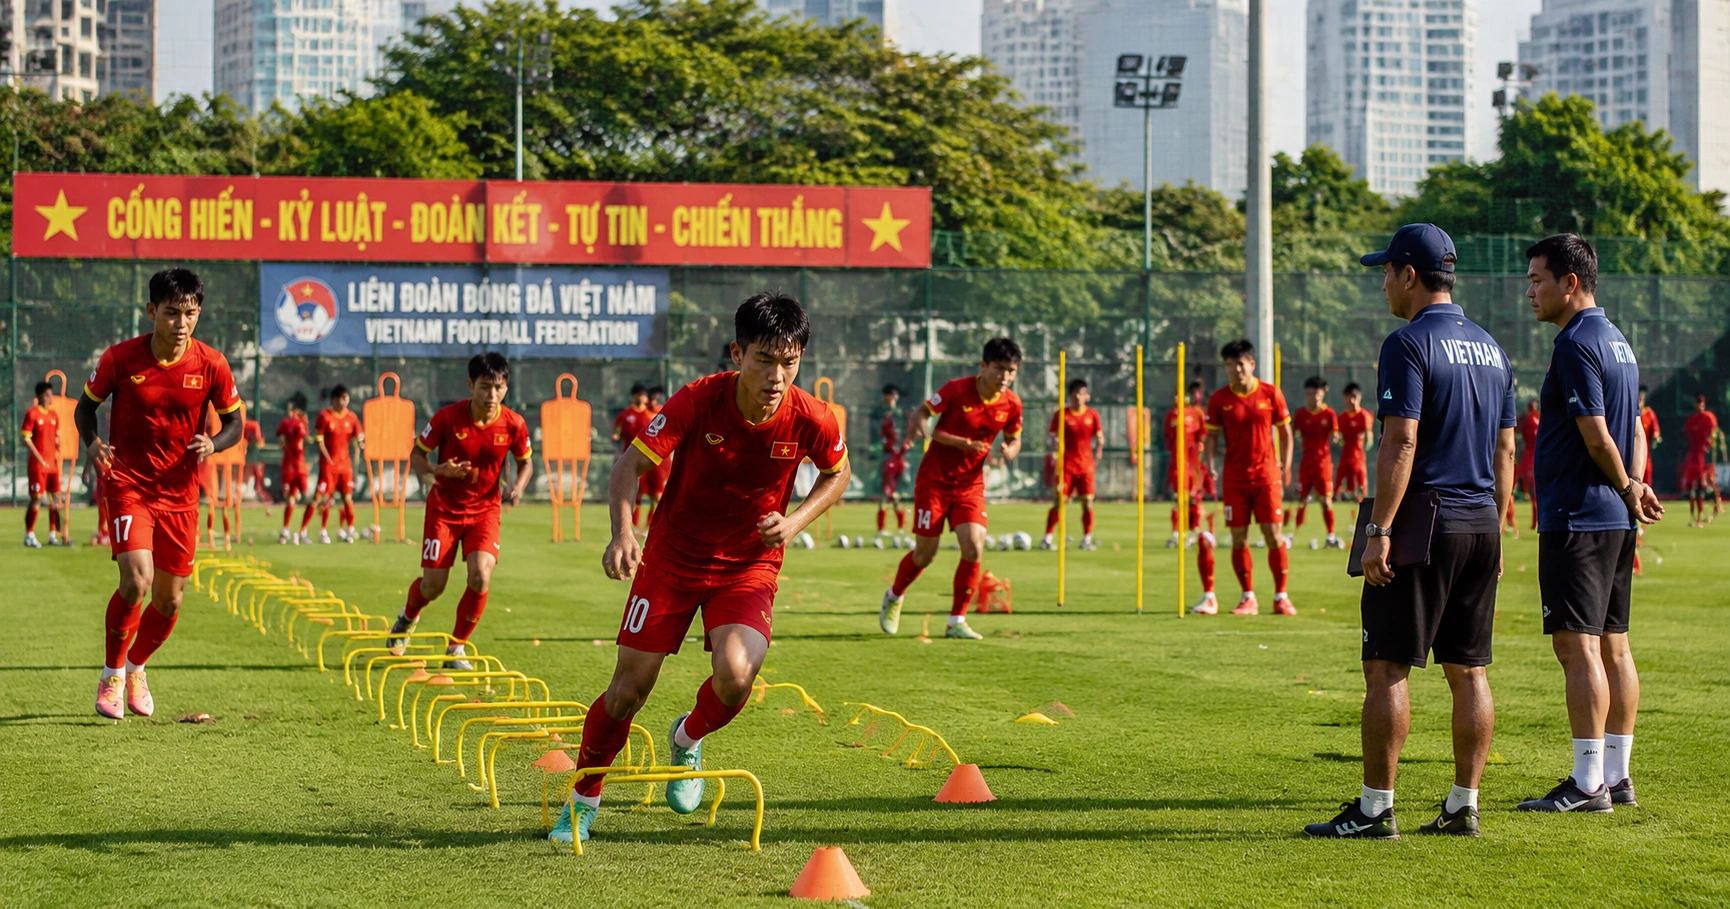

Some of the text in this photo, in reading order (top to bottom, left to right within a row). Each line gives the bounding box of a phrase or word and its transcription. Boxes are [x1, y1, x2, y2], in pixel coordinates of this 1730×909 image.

[107, 182, 843, 254] CỐNG HIẾN - KỶ LUẬT - ĐOÀN KẾT - TỰ TIN - CHIẾN THẮNG
[559, 278, 604, 320] VIỆT
[365, 318, 639, 345] VIETNAM FOOTBALL FEDERATION
[113, 514, 133, 543] 17
[917, 508, 932, 529] 14
[423, 537, 441, 561] 20
[623, 594, 650, 633] 10
